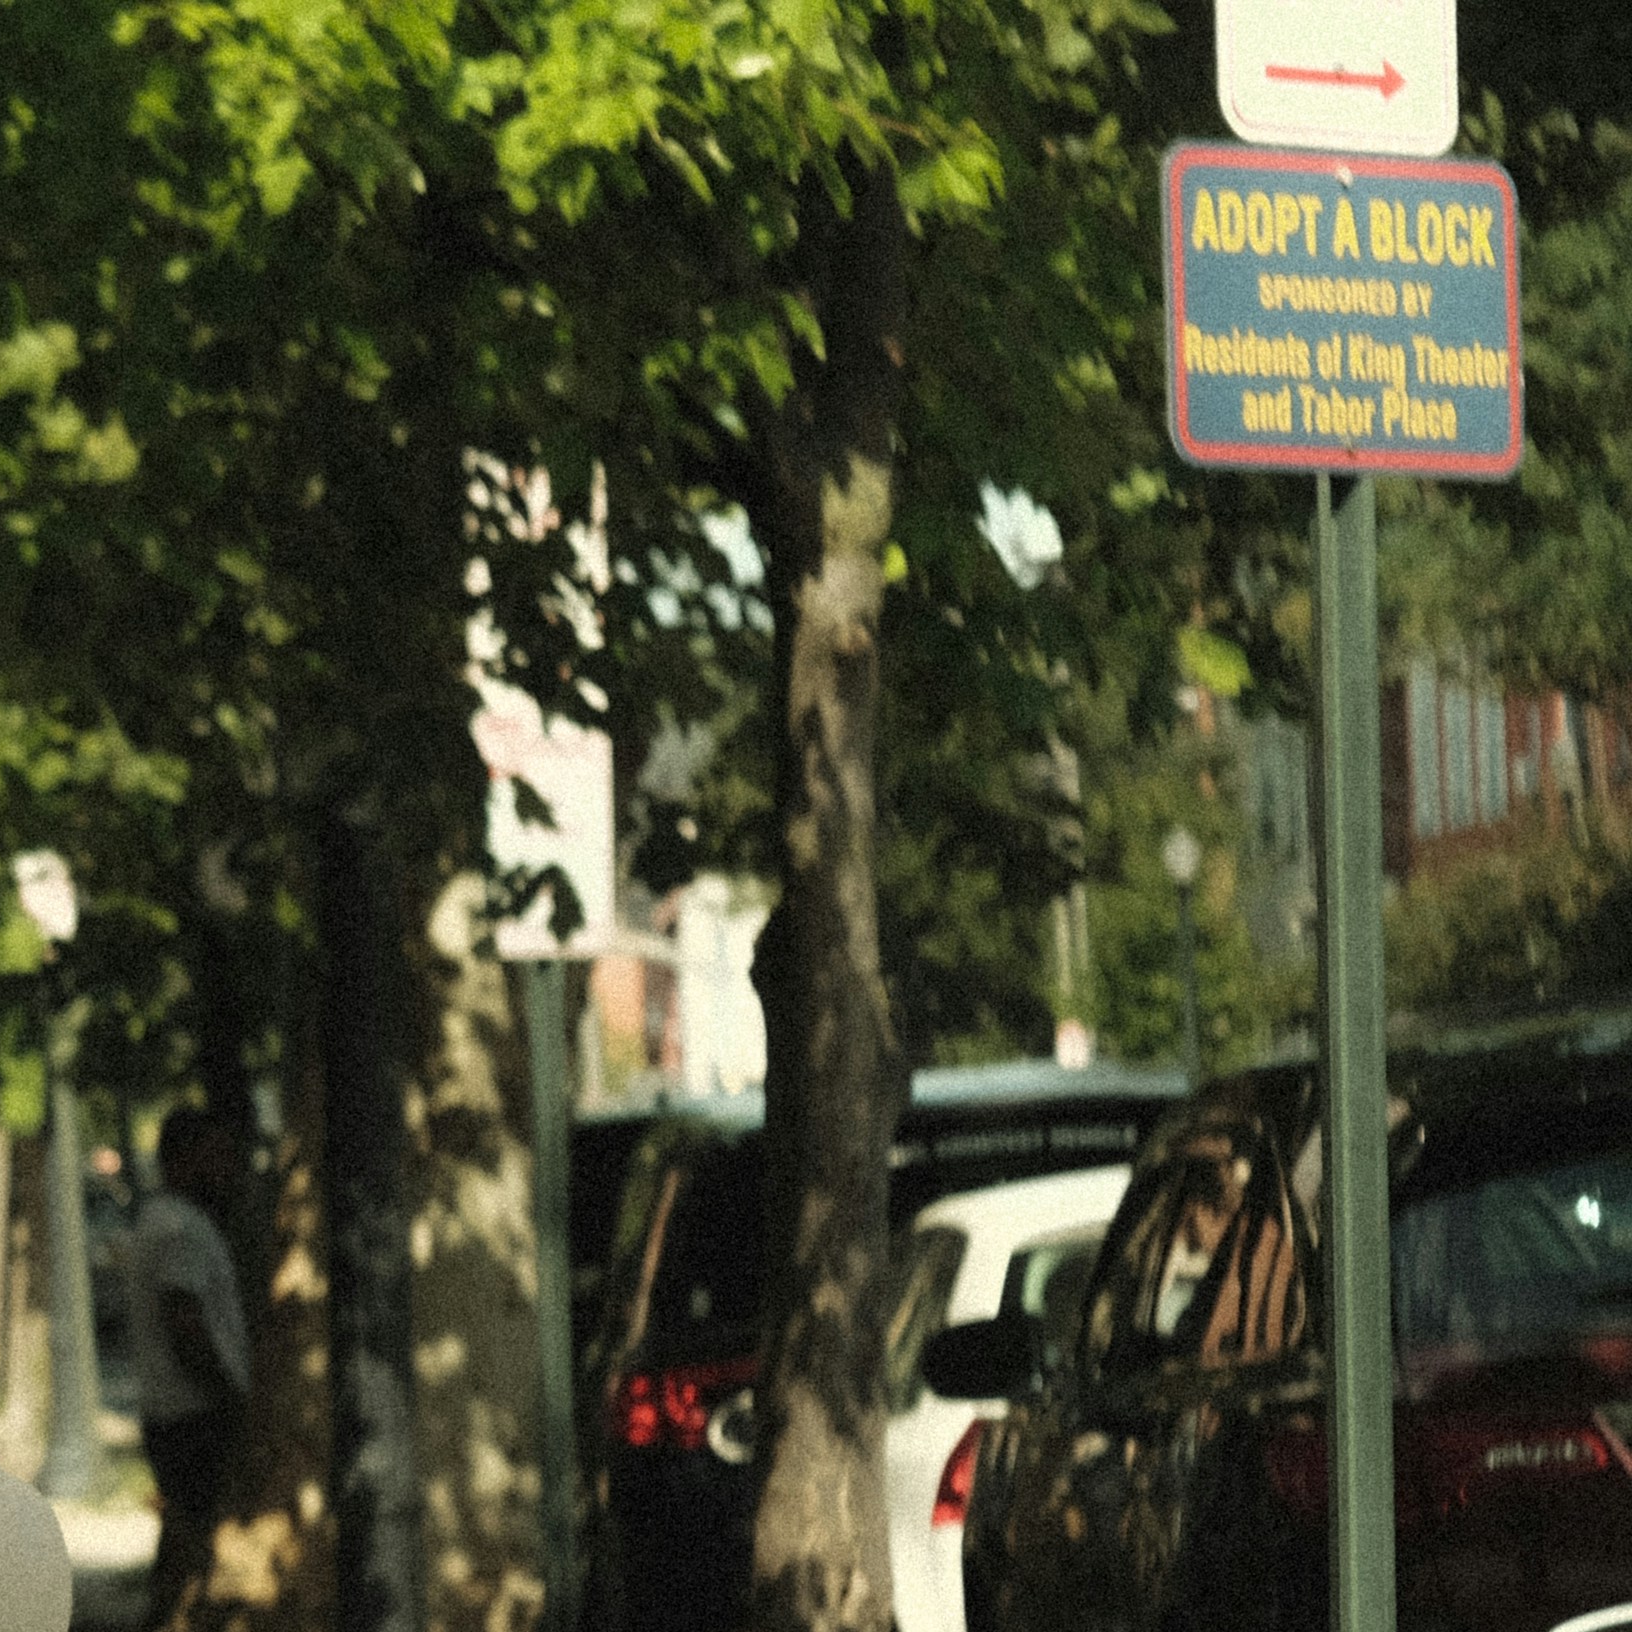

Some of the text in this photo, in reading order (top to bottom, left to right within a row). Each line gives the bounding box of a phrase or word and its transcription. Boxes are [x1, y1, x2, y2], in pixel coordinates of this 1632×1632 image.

[1191, 187, 1496, 268] ADOPT A BLOCK
[1258, 272, 1433, 318] SPONSORED BY
[1184, 323, 1510, 390] Residents of King Theater
[1242, 383, 1457, 440] and Tabor Place
